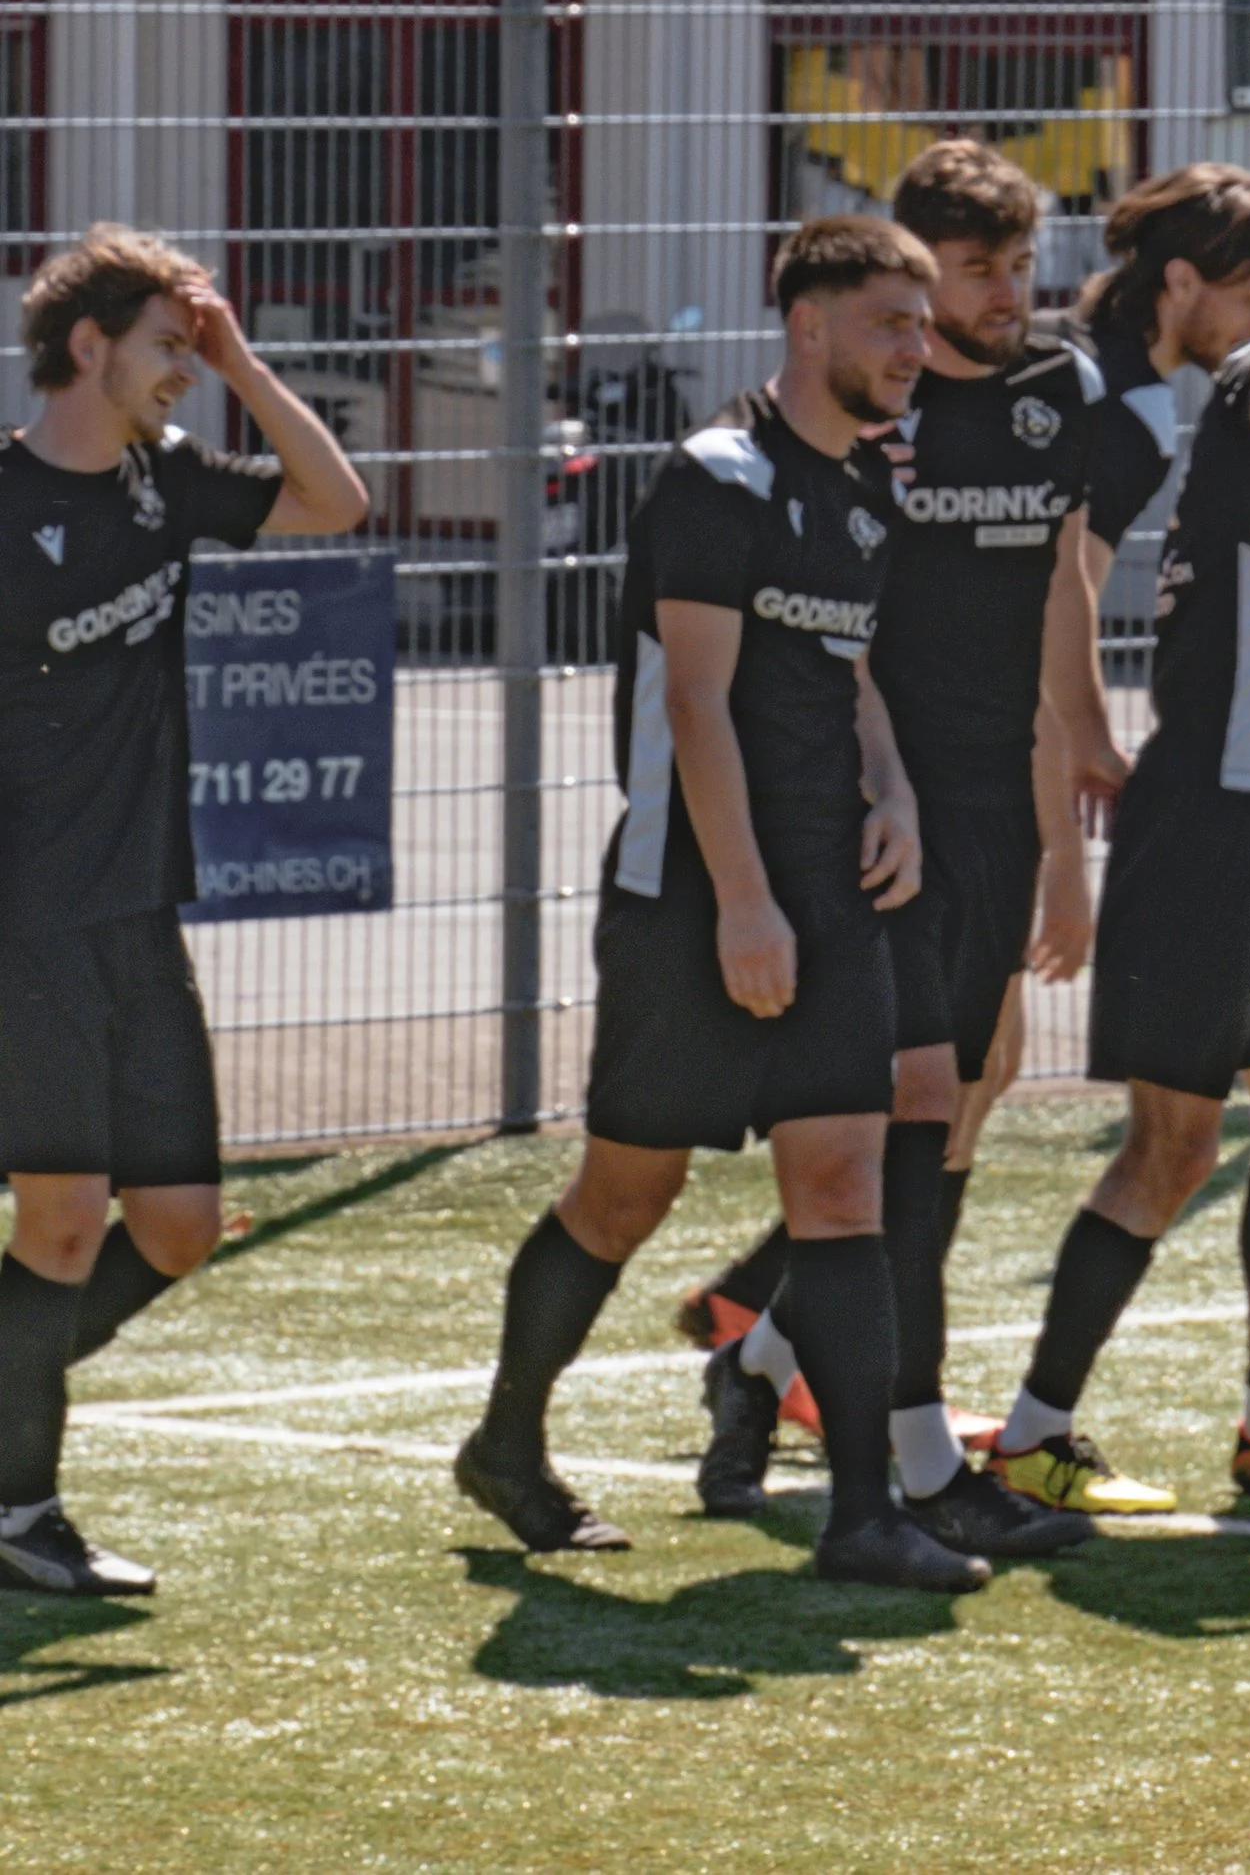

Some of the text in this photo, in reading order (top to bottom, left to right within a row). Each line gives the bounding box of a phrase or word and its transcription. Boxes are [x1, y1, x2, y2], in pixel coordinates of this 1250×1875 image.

[186, 589, 300, 638] ISINES
[186, 650, 376, 710] T PRIVÉES
[189, 755, 364, 805] 711 29 77
[197, 856, 371, 899] ACHINES.CH
